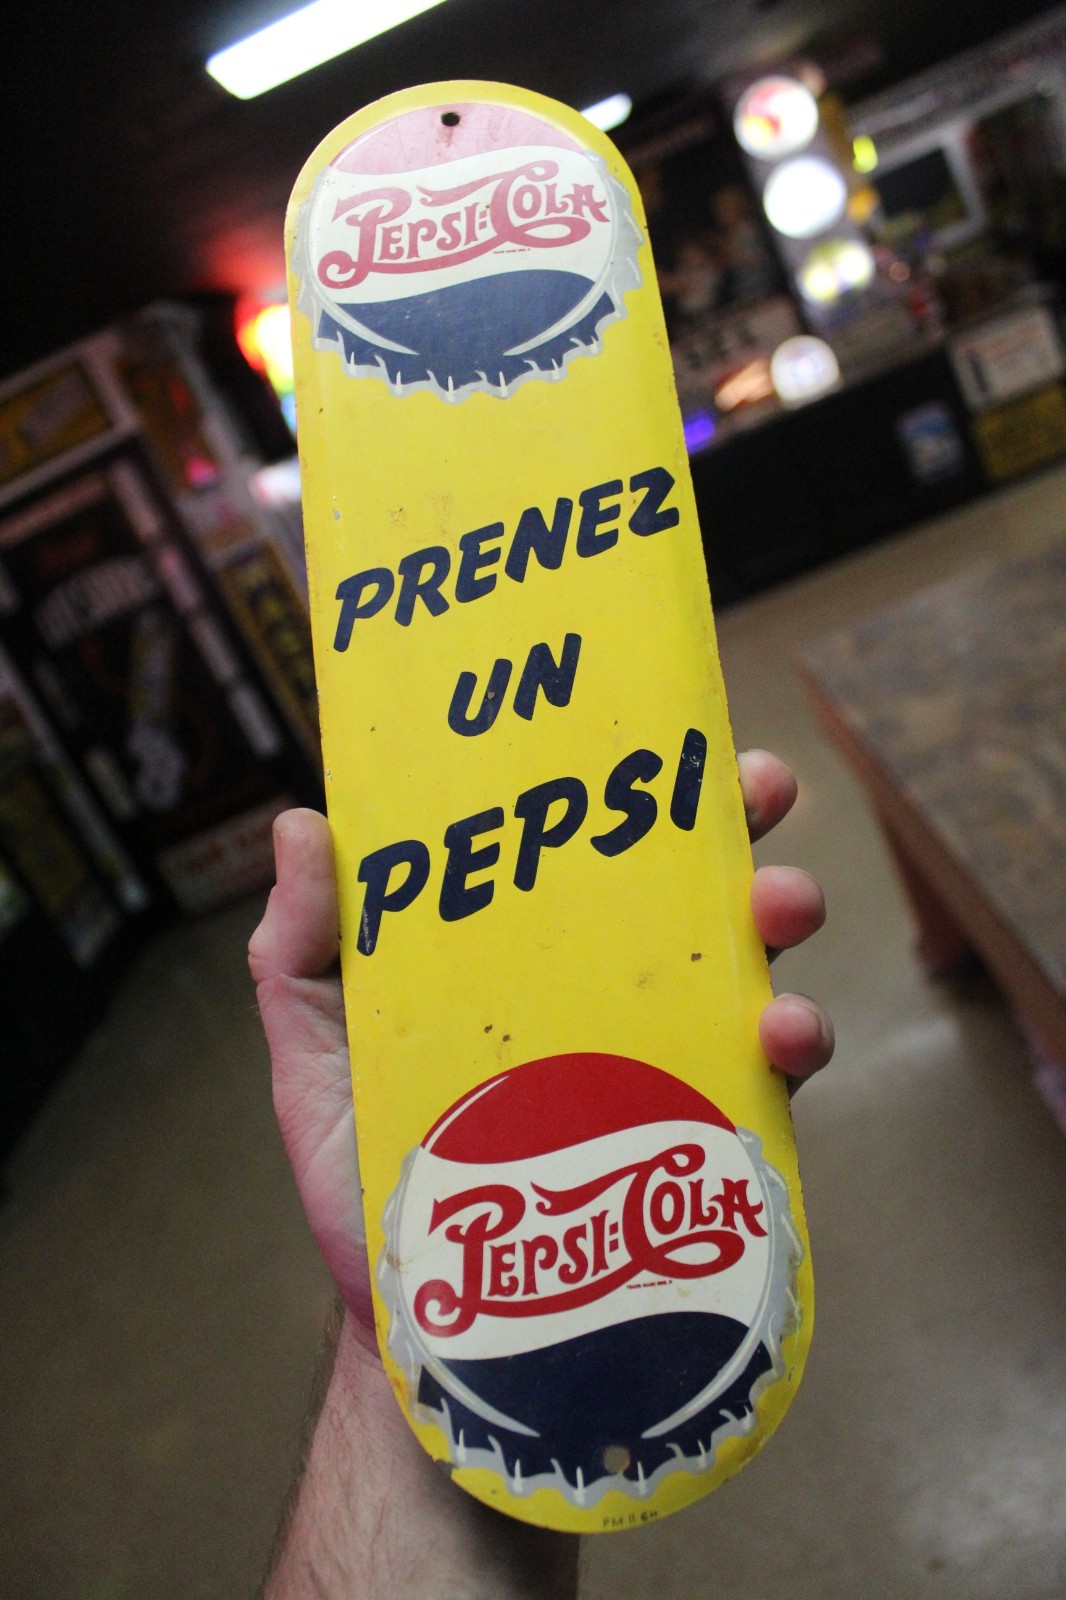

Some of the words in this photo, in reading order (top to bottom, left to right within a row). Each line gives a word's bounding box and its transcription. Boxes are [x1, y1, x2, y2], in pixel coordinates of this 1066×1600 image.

[333, 466, 680, 653] PRENEZ
[447, 632, 583, 738] UN
[356, 728, 708, 957] PEPSI
